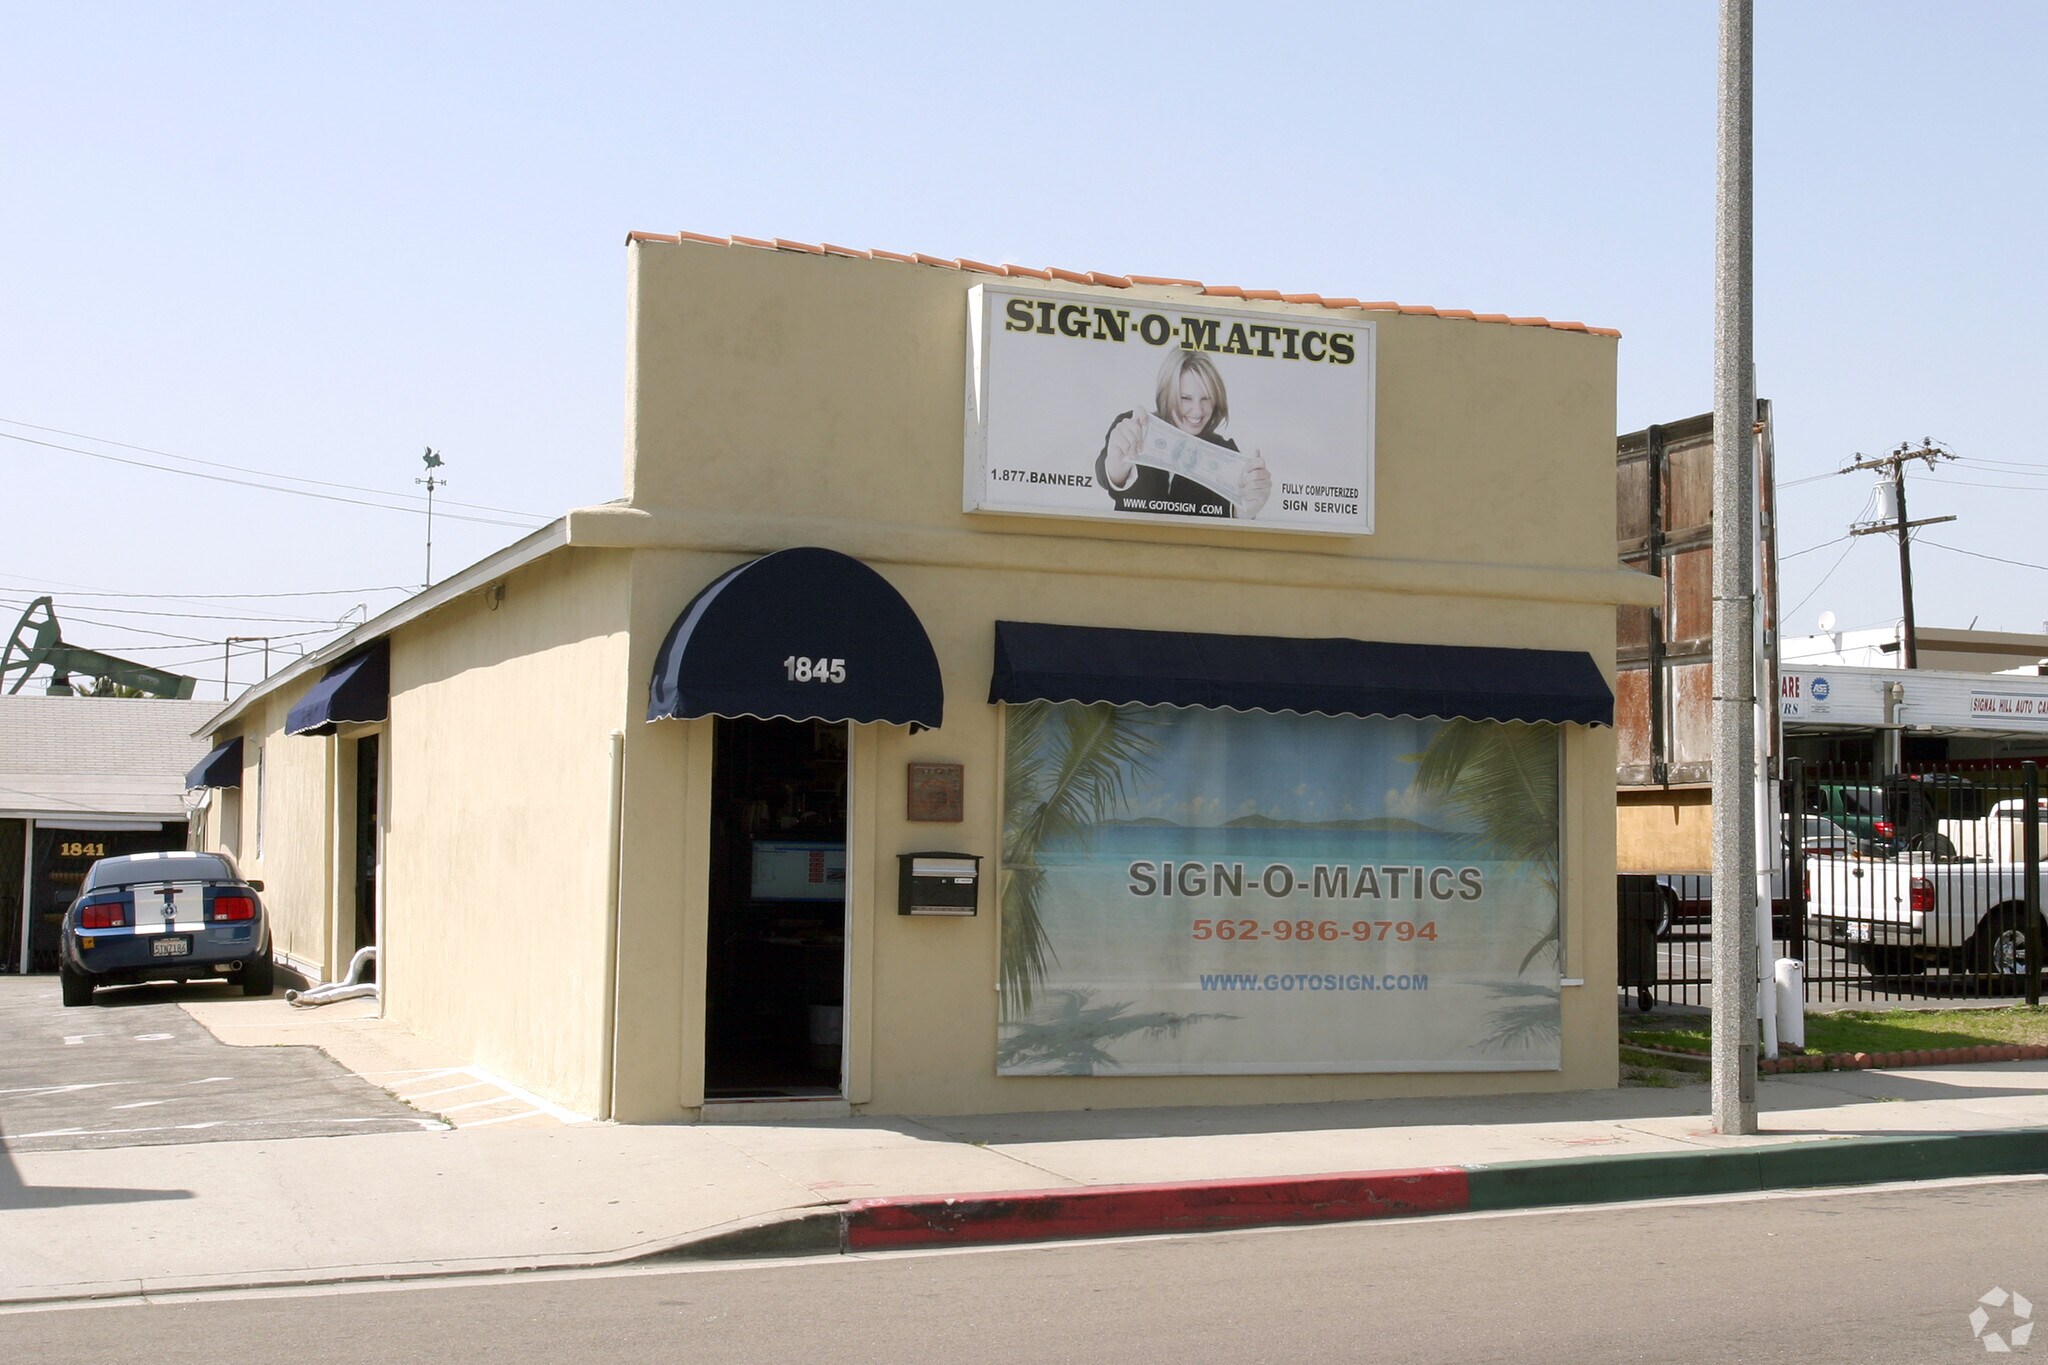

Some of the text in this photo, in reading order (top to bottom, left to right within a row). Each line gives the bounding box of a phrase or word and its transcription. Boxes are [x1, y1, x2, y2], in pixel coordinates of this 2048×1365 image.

[990, 468, 1092, 488] 1.877.BANNERZ
[1282, 483, 1359, 498] FULLY COMPUTERIZED
[1122, 497, 1223, 515] WWW. GOTOSIGN .COM
[1282, 499, 1358, 514] SIGN SERVICE
[783, 655, 847, 684] 1845
[1812, 684, 1828, 693] ASE
[1781, 703, 1799, 715] RS
[1974, 698, 1996, 712] SIGNAL
[1999, 699, 2013, 713] HILL
[2015, 700, 2033, 713] AUTO
[61, 842, 104, 856] 1841
[1128, 861, 1483, 901] SIGN-O-MATICS
[1192, 919, 1438, 942] 562-986-9794
[1199, 974, 1429, 992] WWW.GOTOSIGN.COM
